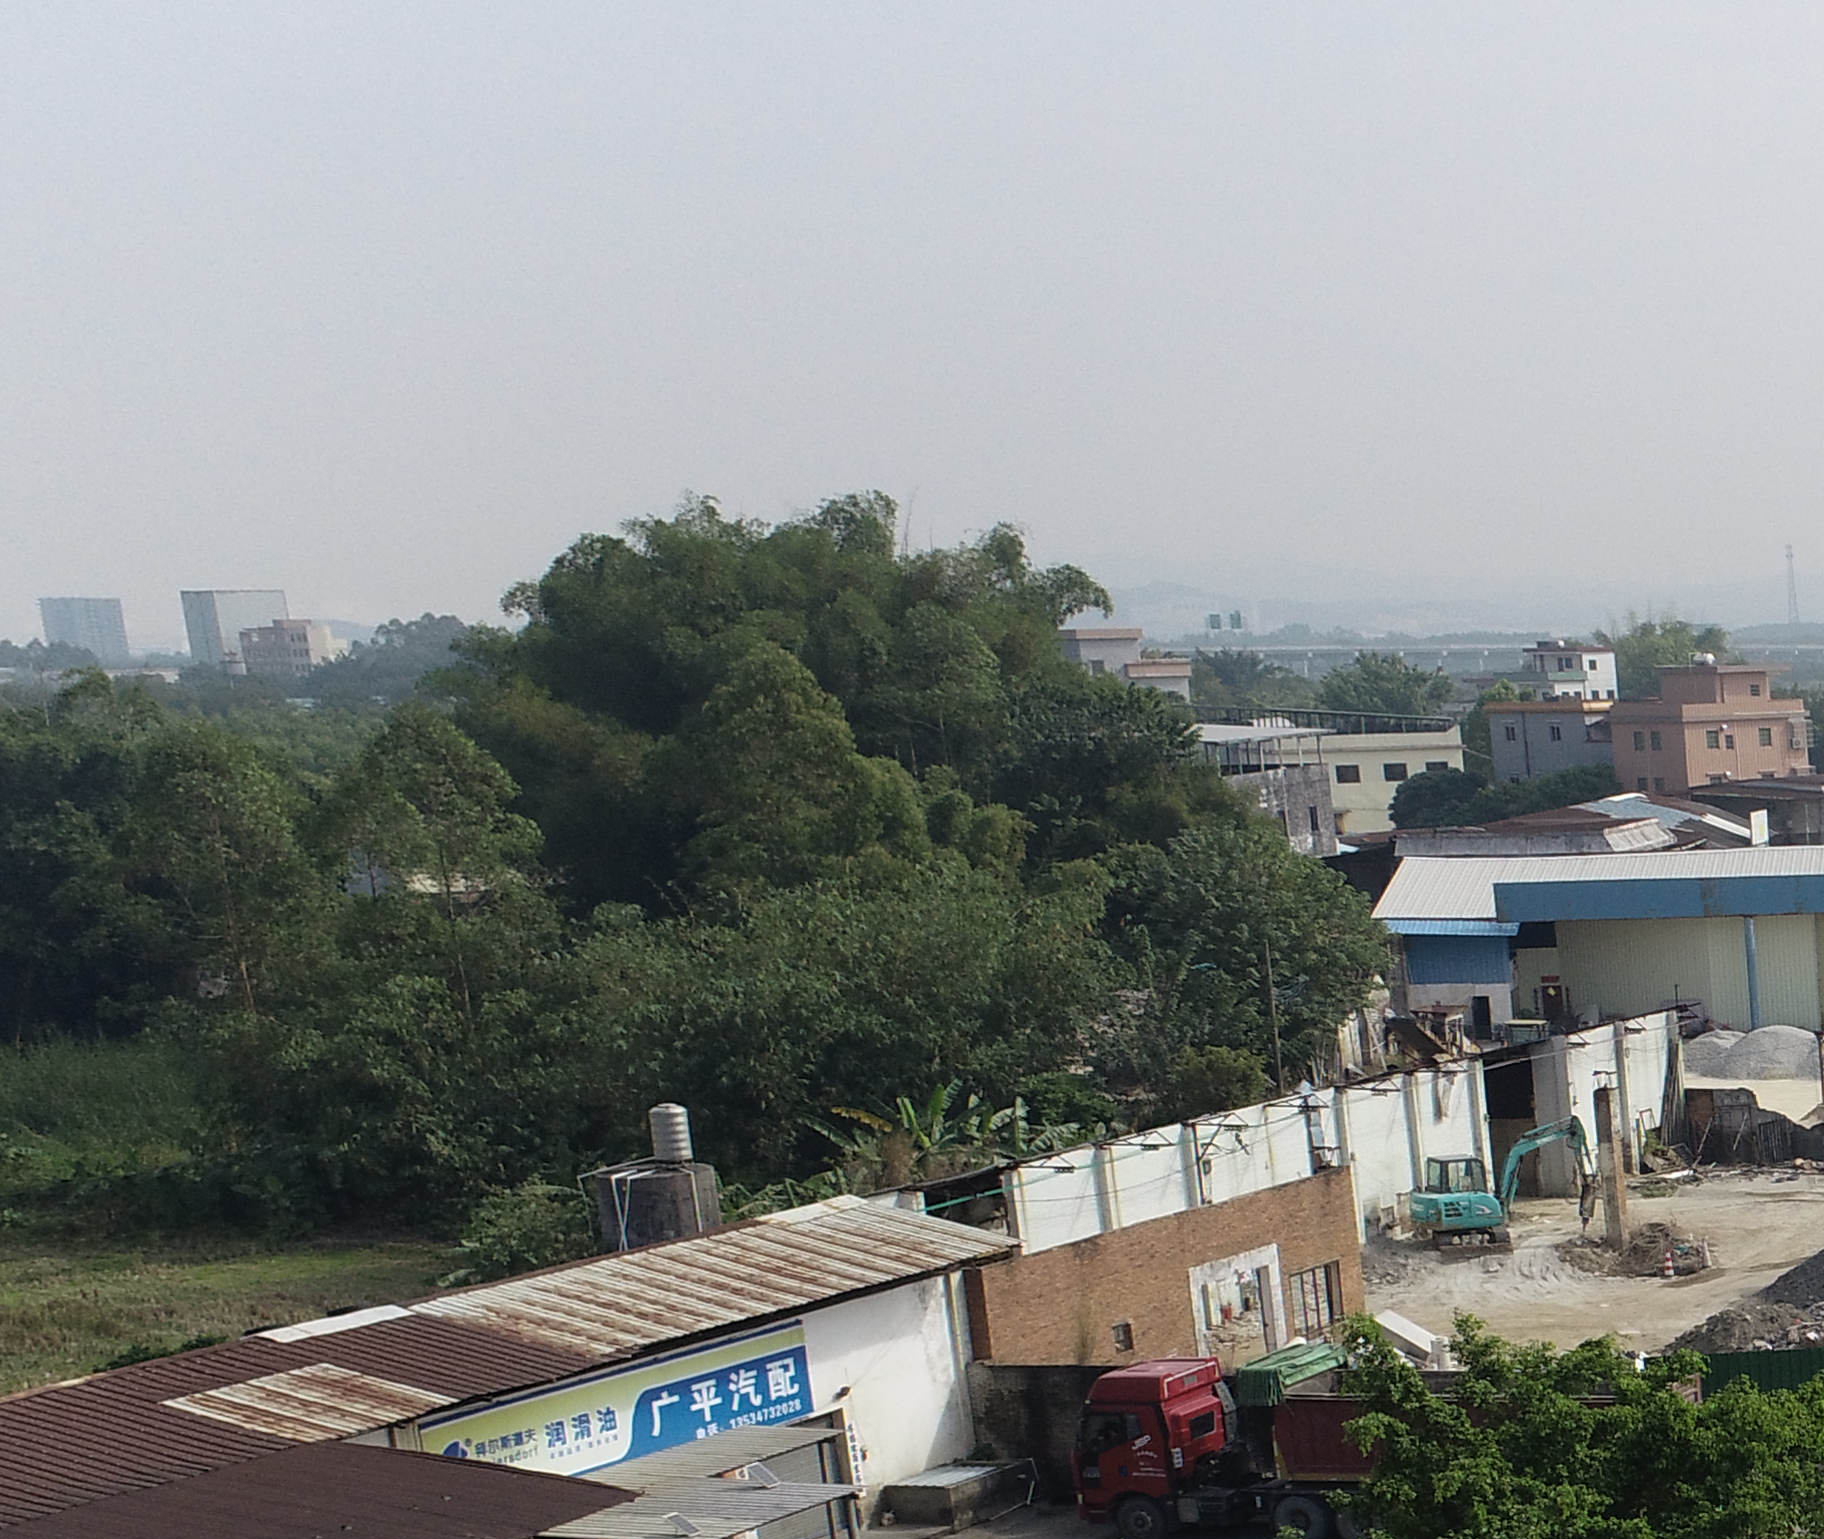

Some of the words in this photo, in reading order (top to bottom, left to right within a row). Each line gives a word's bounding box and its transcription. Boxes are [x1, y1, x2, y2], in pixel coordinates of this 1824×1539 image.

[650, 1356, 800, 1438] 广平汽配
[729, 1397, 803, 1431] 13534732028
[544, 1405, 619, 1449] 润滑油
